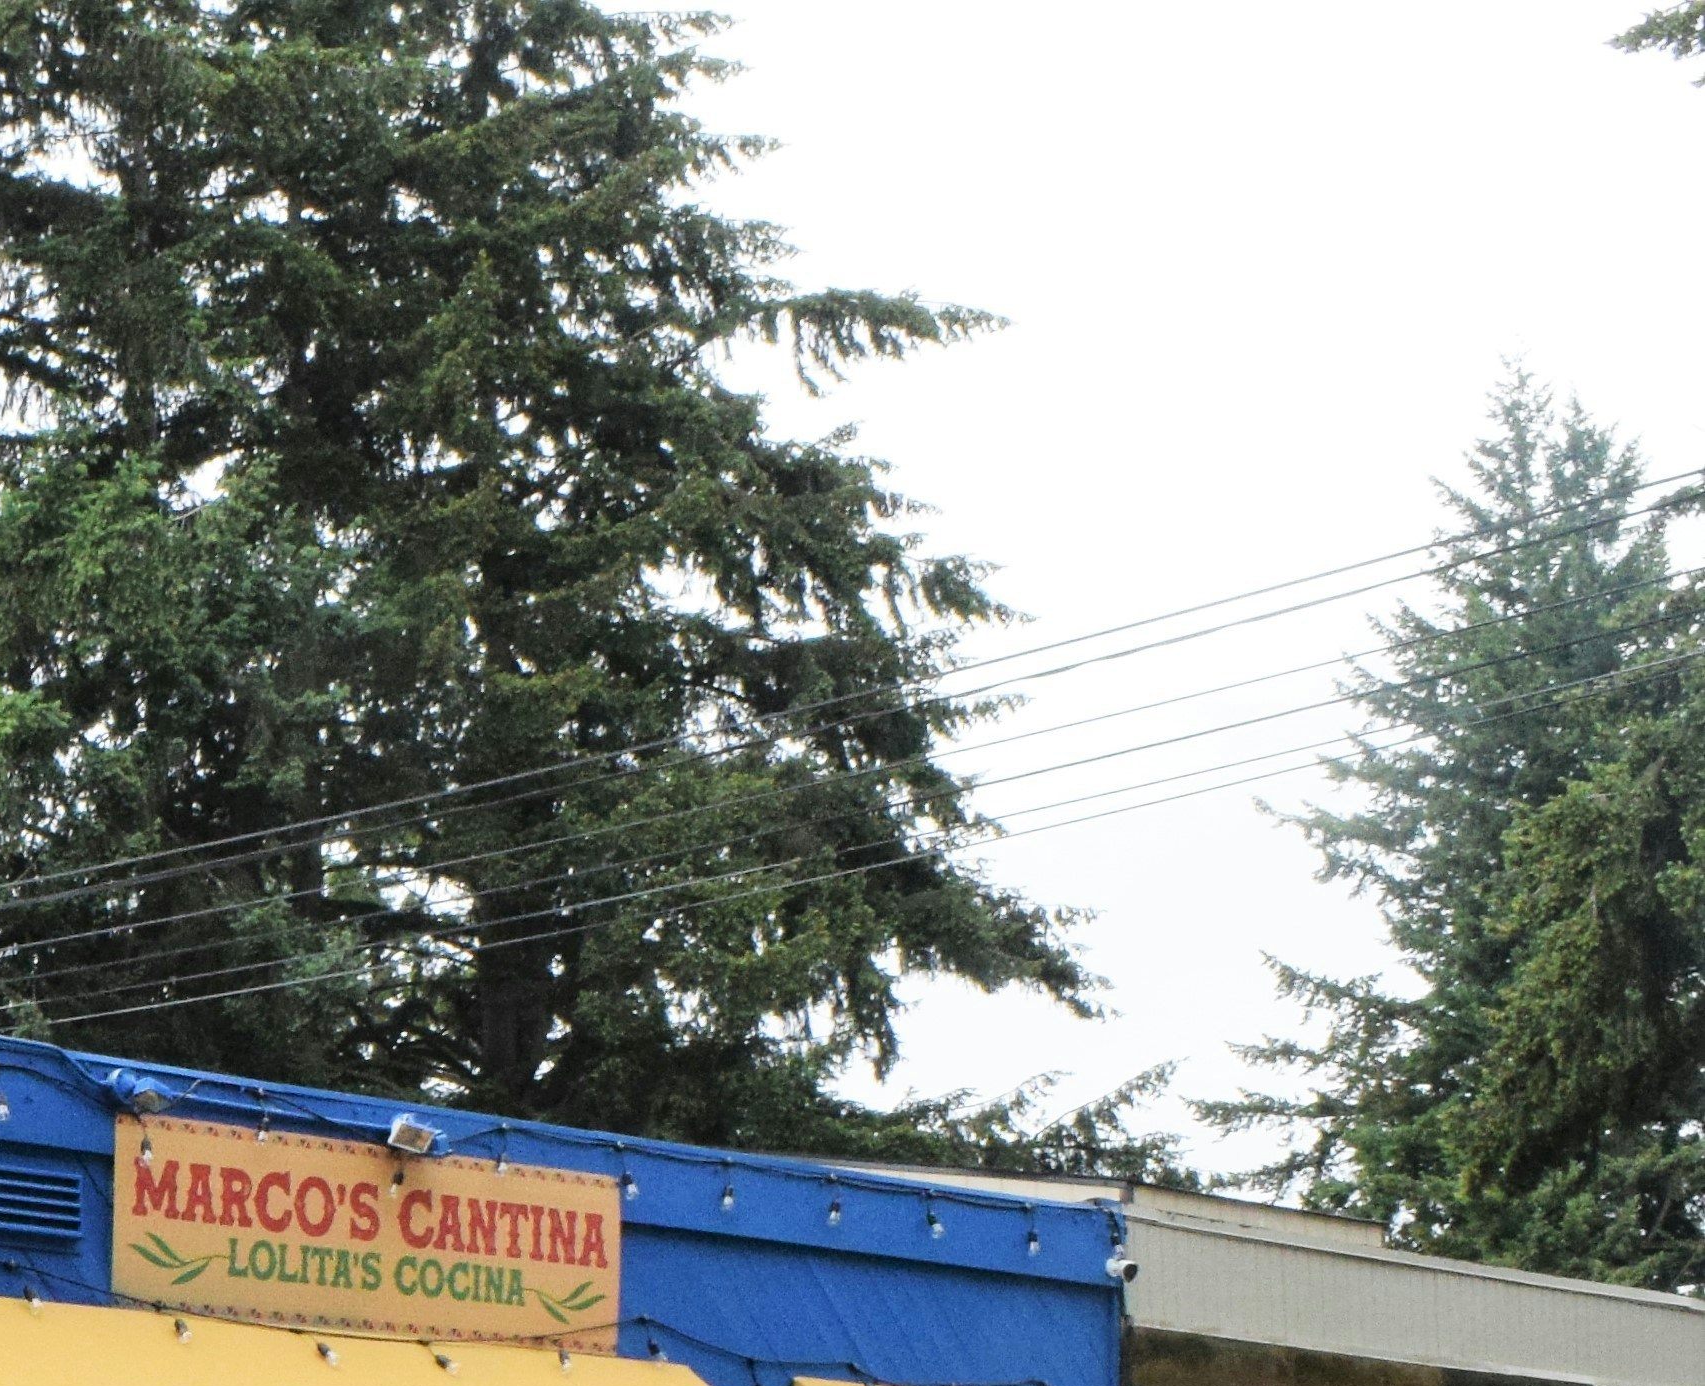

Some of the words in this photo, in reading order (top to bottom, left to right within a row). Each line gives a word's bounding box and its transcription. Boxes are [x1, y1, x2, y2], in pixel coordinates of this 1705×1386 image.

[131, 1155, 381, 1242] MARCO'S
[397, 1188, 609, 1269] CANTINA
[227, 1237, 383, 1292] LOLITA'S
[393, 1255, 526, 1307] COCINA
